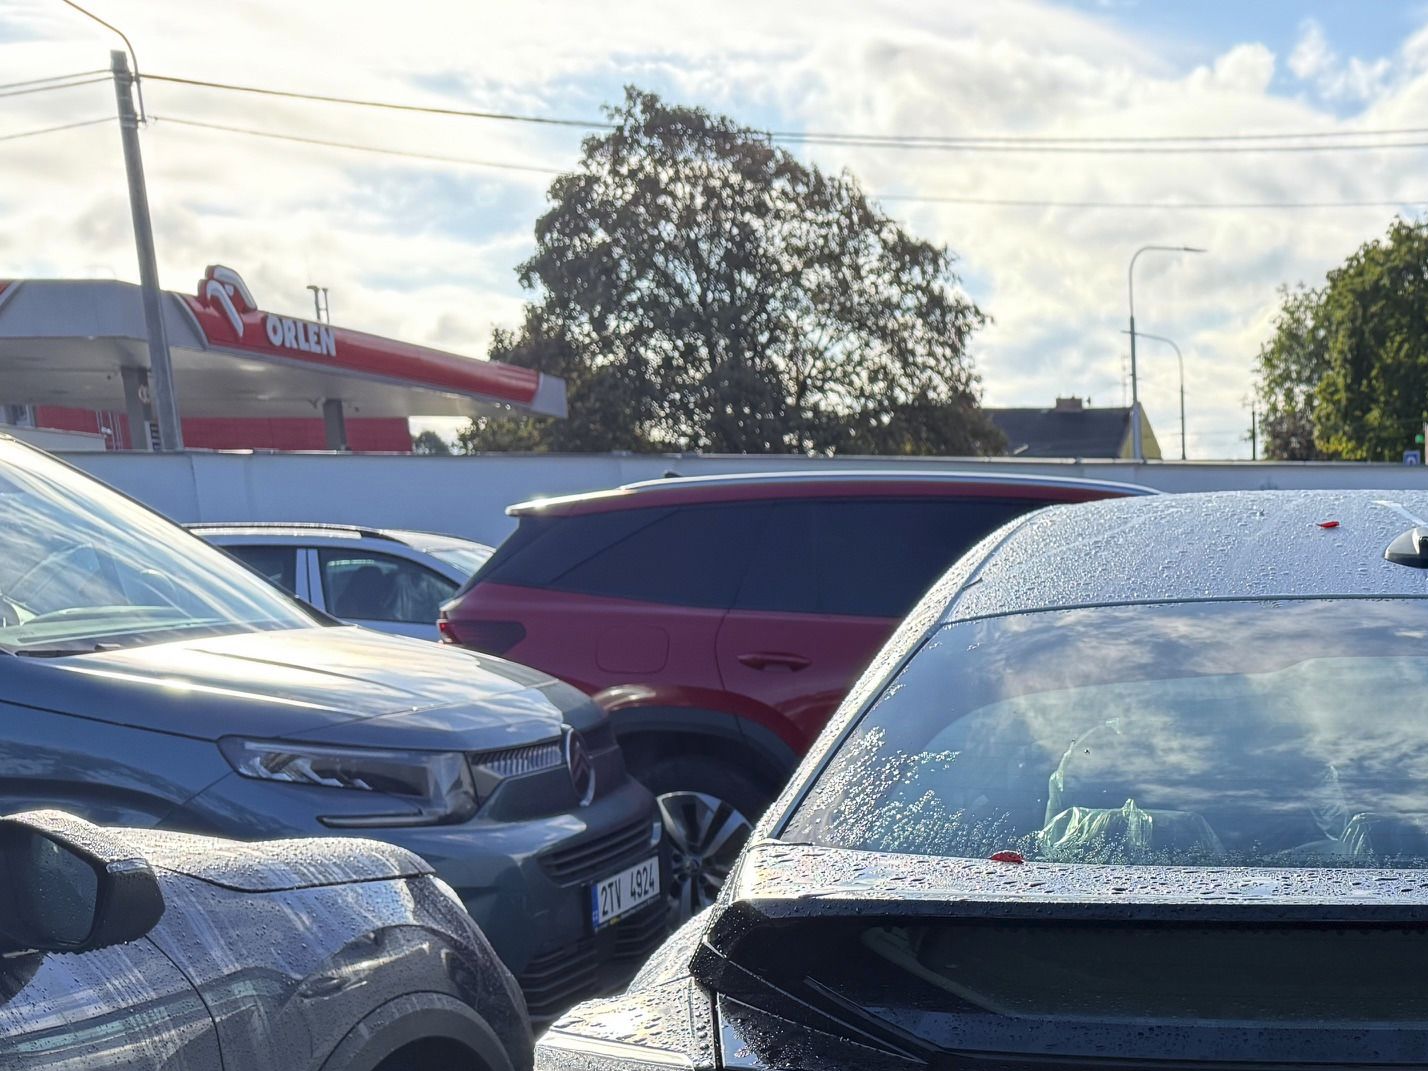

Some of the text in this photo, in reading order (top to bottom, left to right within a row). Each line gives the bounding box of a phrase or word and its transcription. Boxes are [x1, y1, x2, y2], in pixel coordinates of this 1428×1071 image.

[266, 314, 337, 358] ORLEN
[601, 863, 655, 917] 2TV 4924
